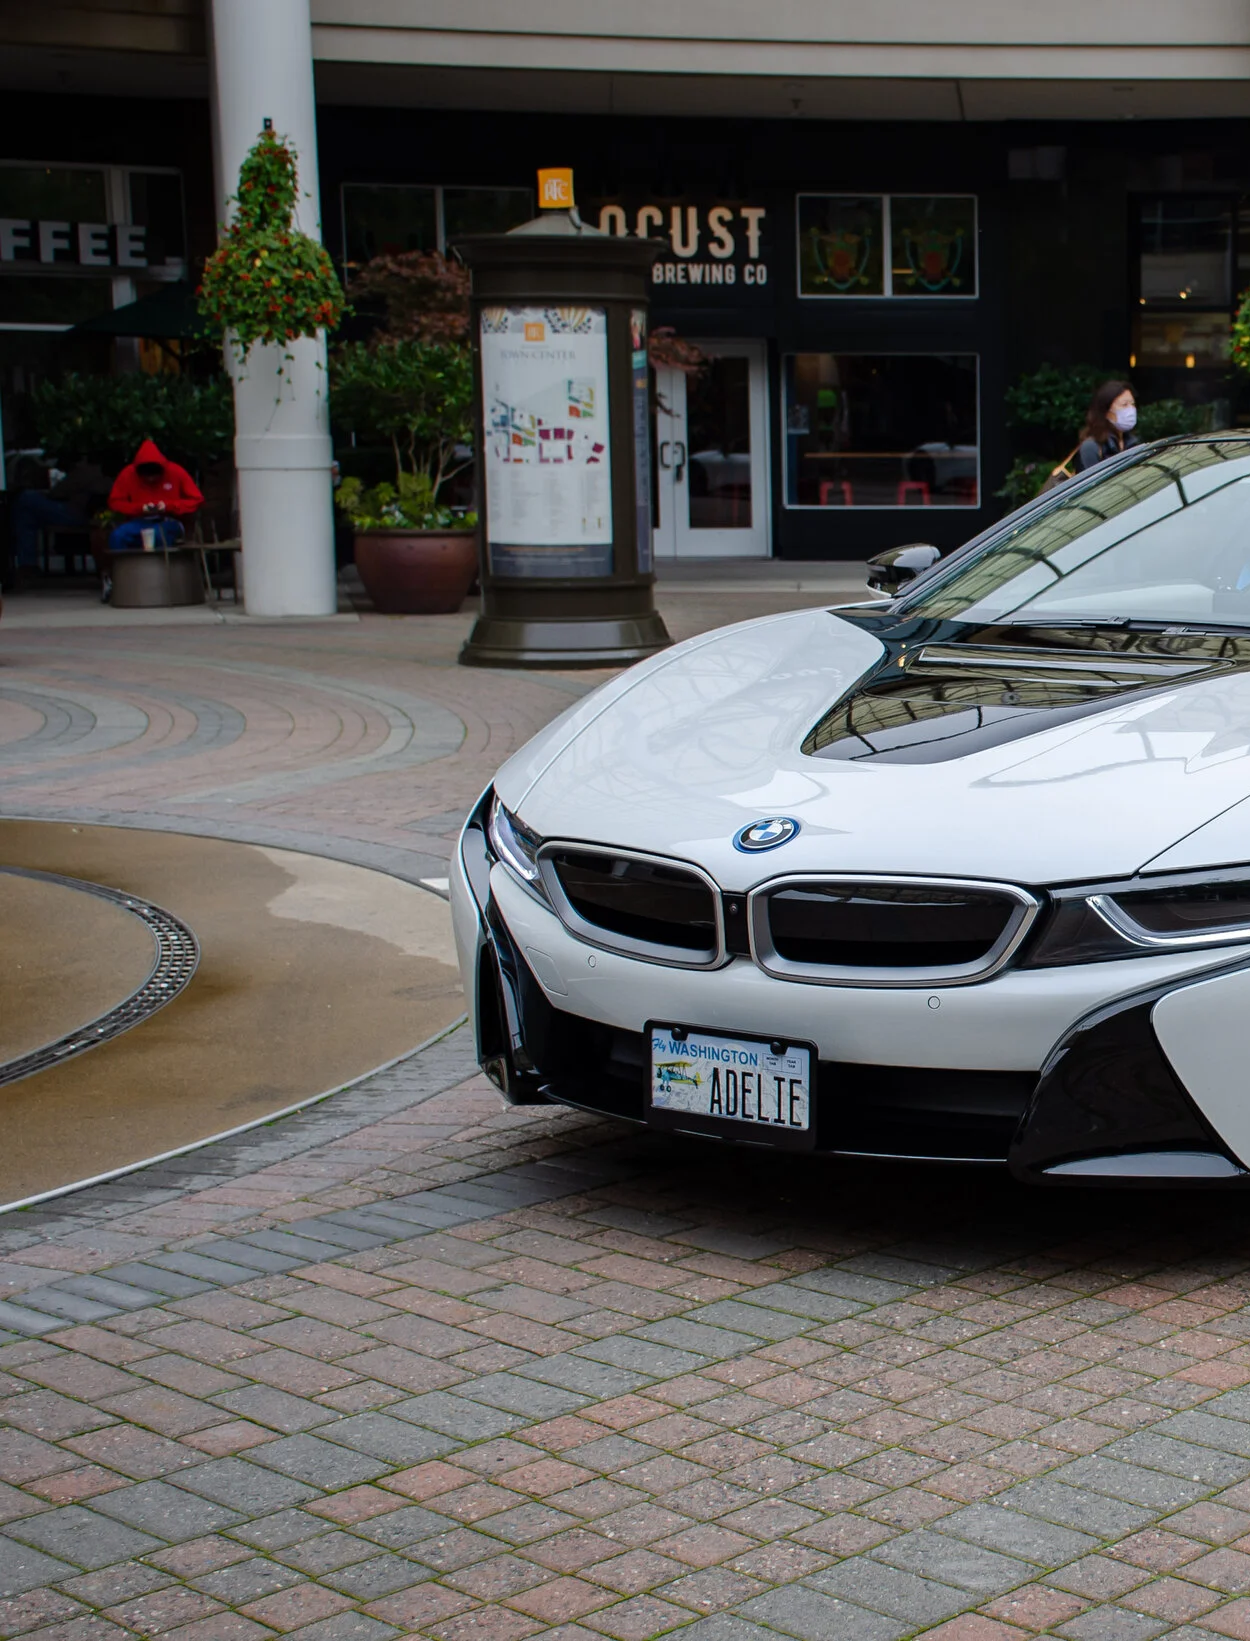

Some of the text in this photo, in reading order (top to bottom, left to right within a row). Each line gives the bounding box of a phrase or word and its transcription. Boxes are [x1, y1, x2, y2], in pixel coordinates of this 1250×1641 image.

[0, 218, 148, 268] FFEE
[652, 263, 767, 285] BREWING CO
[652, 1037, 758, 1067] Fly WASHINGTON
[710, 1067, 803, 1127] ADELIE
